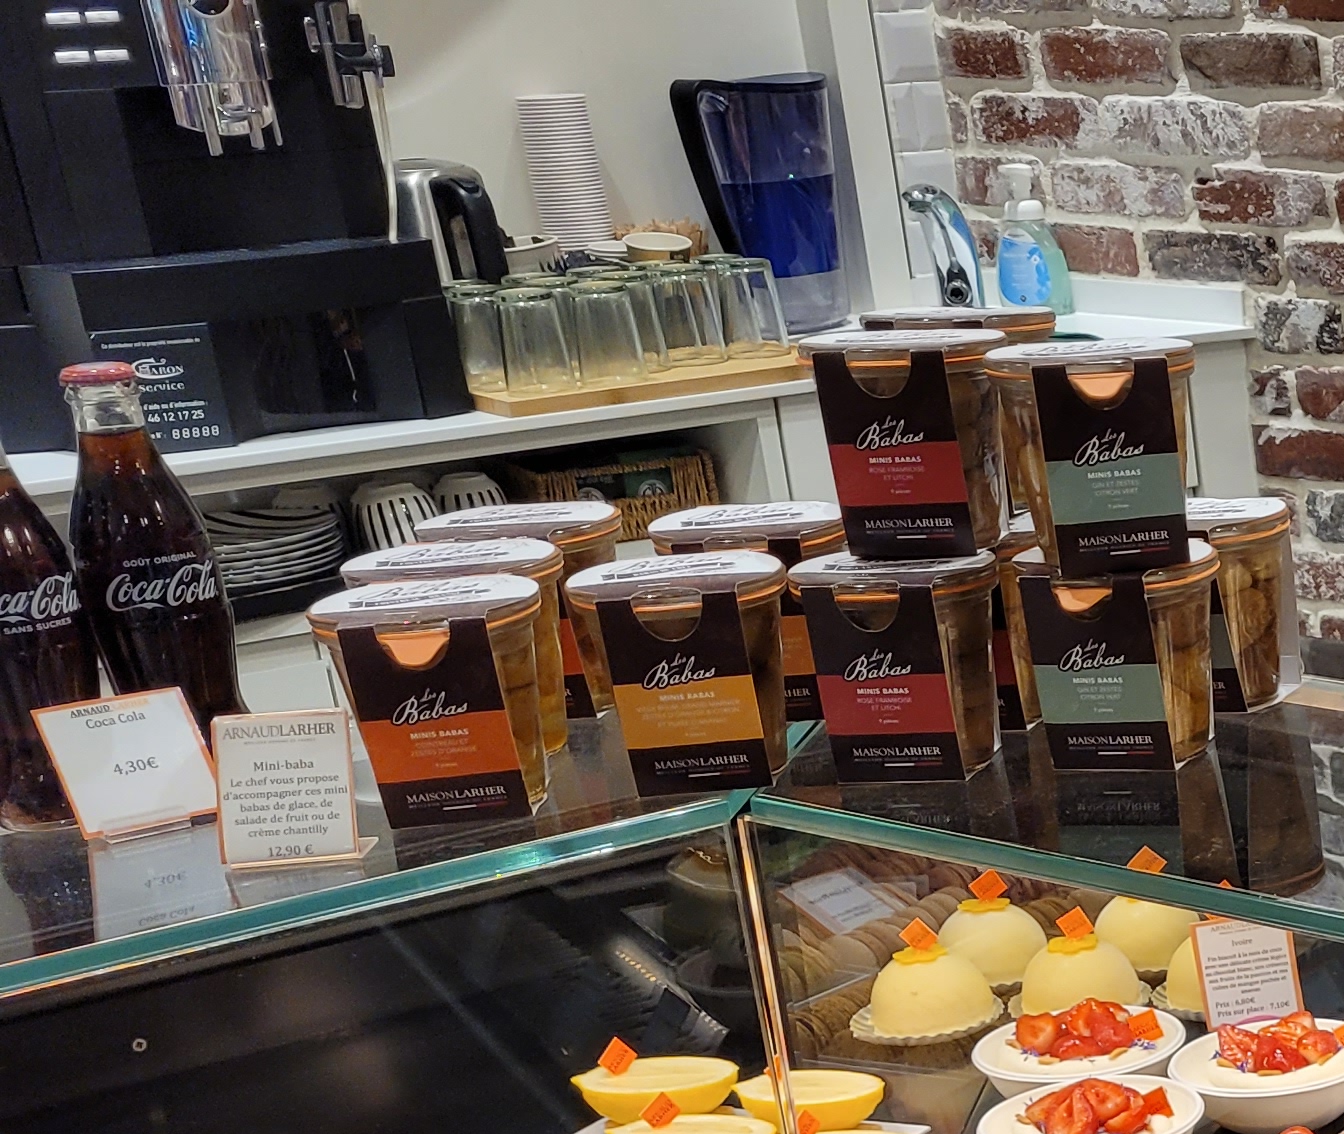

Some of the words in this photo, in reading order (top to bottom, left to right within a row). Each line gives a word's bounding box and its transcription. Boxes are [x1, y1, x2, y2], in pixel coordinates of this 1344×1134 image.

[147, 411, 160, 423] 46
[164, 411, 175, 422] 12
[177, 410, 189, 421] 17
[191, 409, 205, 420] 25
[171, 425, 220, 440] 88888
[856, 419, 924, 450] Babas
[1074, 431, 1145, 466] Babas
[868, 456, 892, 464] MINIS
[895, 456, 921, 464] BABAS
[1087, 470, 1112, 479] MINIS
[1114, 468, 1142, 477] BABAS
[122, 557, 151, 568] GOÛT
[153, 551, 197, 565] ORIGINAL
[106, 559, 218, 612] Coca-Cola
[0, 571, 82, 623] ca-Cola
[3, 624, 34, 635] SANS
[36, 616, 72, 631] SUCRES
[1059, 642, 1125, 671] Babas
[643, 655, 716, 689] Babas
[844, 652, 912, 681] Babas
[856, 687, 881, 695] MINIS
[70, 704, 110, 719] ARNAUD
[393, 691, 468, 724] Babas
[85, 715, 117, 730] Coca
[118, 711, 146, 724] Cola
[222, 722, 335, 741] ARNAUDLARHER
[113, 756, 159, 776] 4,30€
[253, 759, 314, 772] Mini-baba
[230, 778, 243, 788] Le
[245, 776, 267, 787] chef
[270, 777, 294, 785] vous
[297, 774, 339, 787] propose
[223, 788, 302, 803] d'accompagner
[305, 788, 321, 796] ces
[324, 785, 348, 795] mini
[240, 802, 271, 813] babas
[274, 801, 286, 811] de
[288, 800, 318, 813] glace,
[320, 800, 333, 808] de
[234, 814, 267, 826] salade
[270, 813, 283, 823] de
[285, 811, 309, 823] fruit
[311, 813, 325, 821] ou
[327, 810, 340, 820] de
[247, 826, 281, 838] crème
[283, 823, 329, 837] chantilly
[268, 845, 302, 858] 12,90
[304, 844, 314, 855] €
